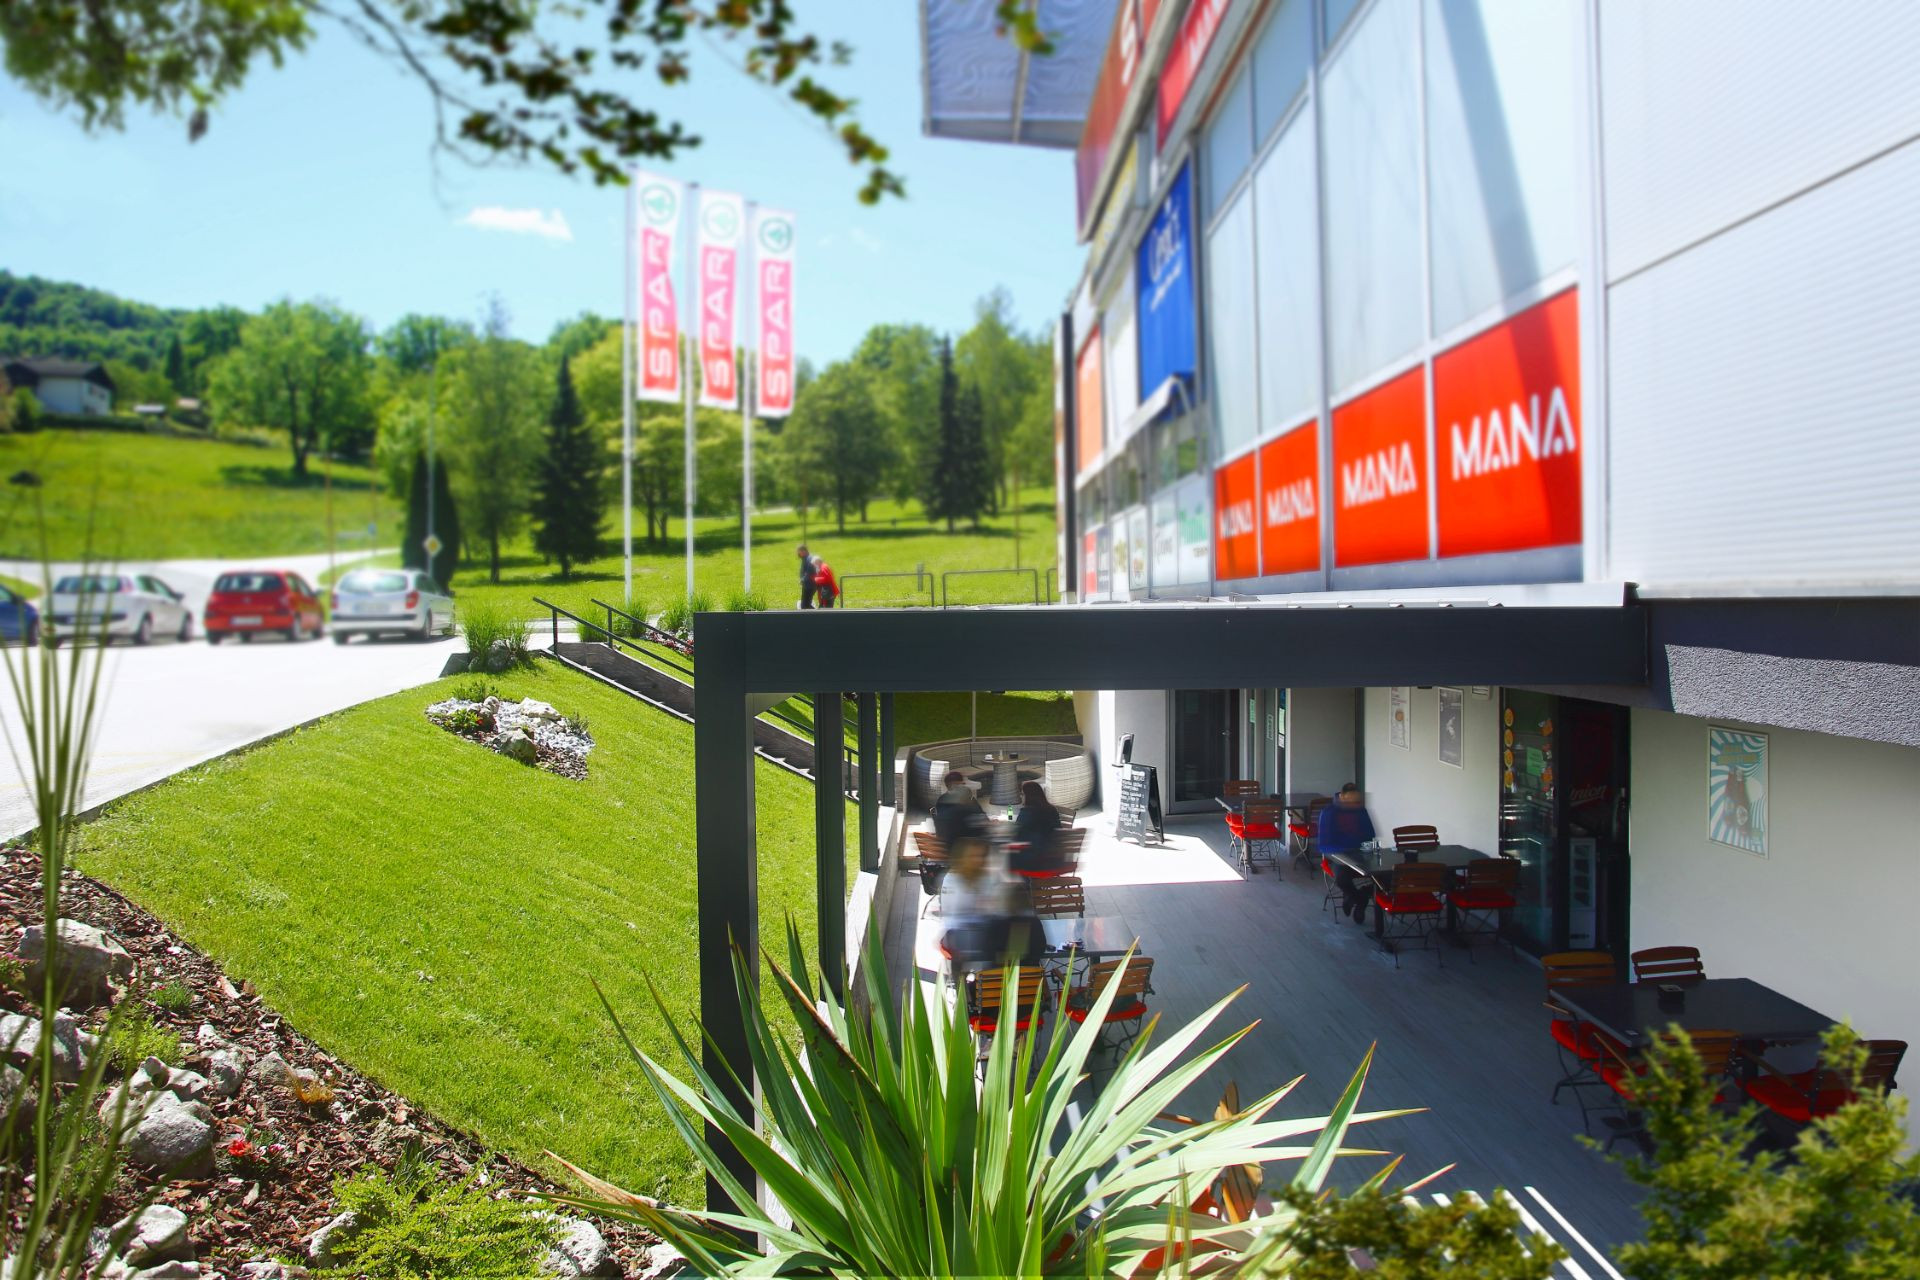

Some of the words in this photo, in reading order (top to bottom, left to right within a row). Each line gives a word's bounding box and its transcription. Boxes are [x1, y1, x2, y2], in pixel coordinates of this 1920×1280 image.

[648, 232, 674, 379] SPAR
[706, 250, 731, 389] SPAR
[765, 263, 788, 399] SPAR
[1342, 440, 1418, 509] MANA
[1451, 386, 1576, 481] MANA
[1266, 476, 1316, 528] MANA
